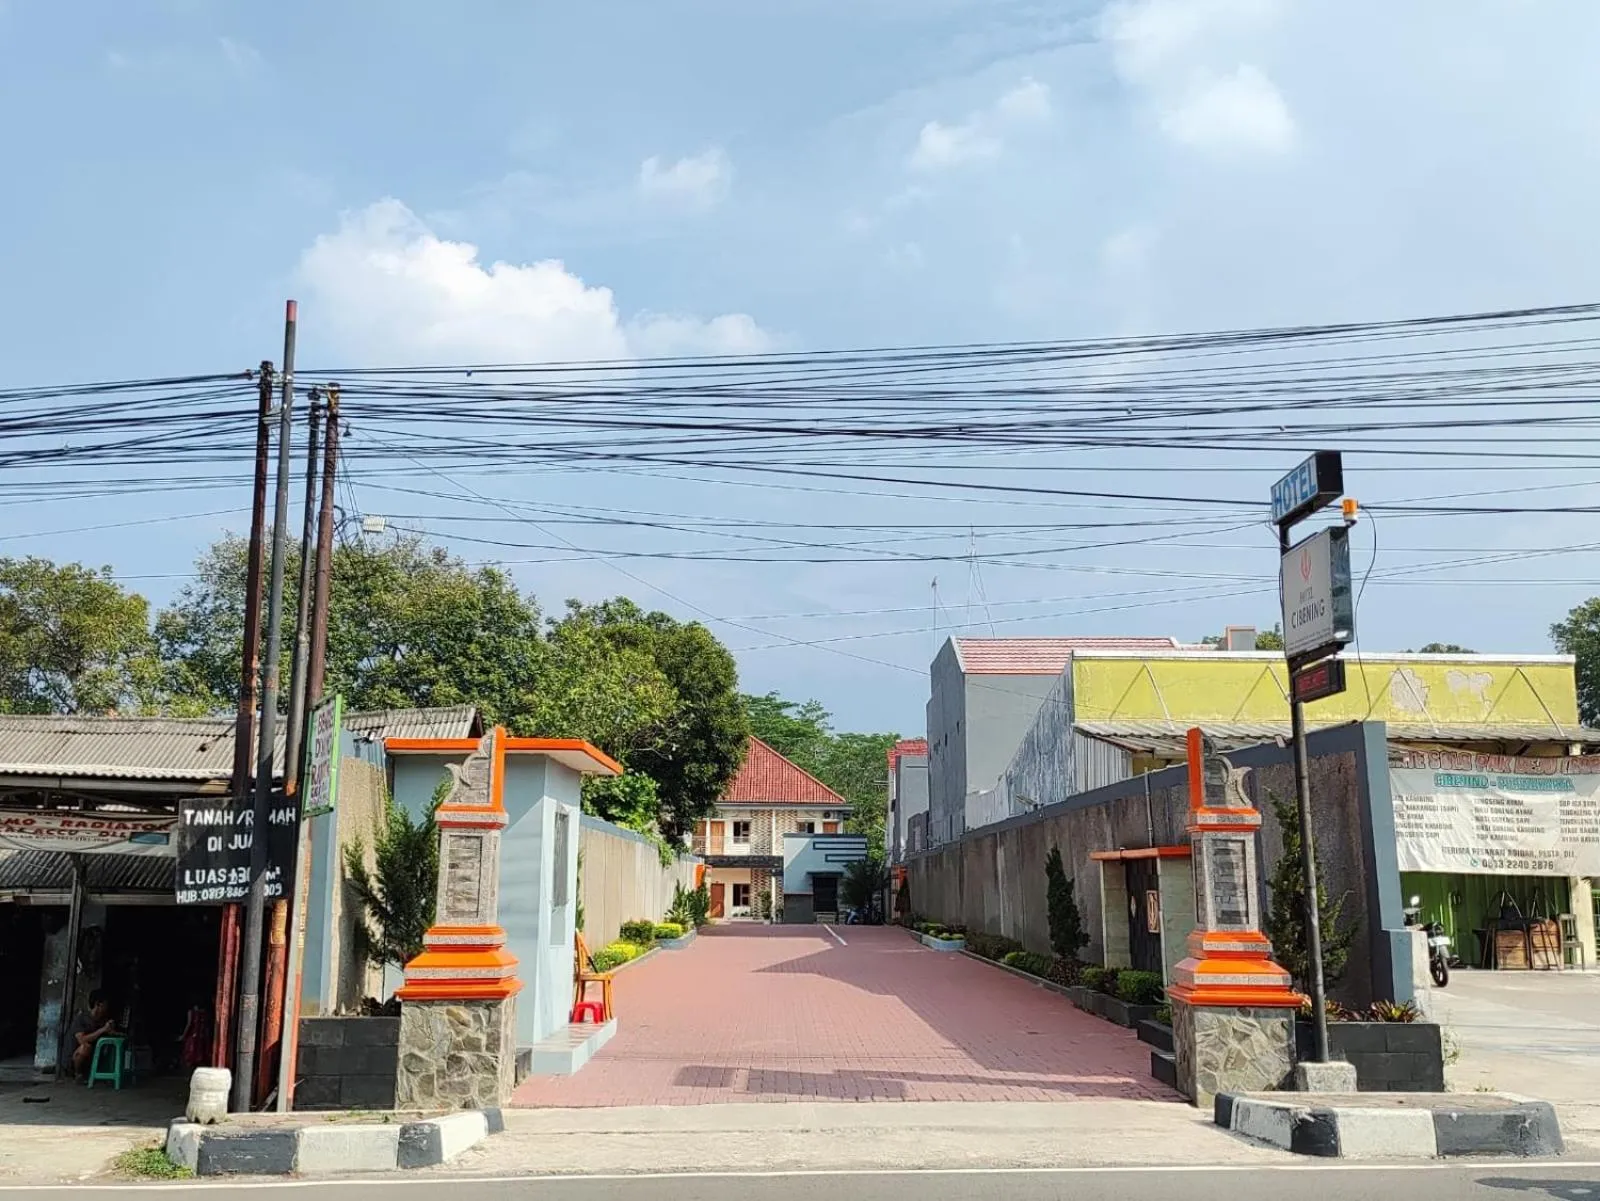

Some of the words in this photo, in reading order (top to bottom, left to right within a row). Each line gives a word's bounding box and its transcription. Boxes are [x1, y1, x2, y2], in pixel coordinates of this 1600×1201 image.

[1273, 460, 1317, 519] HOTEL
[207, 836, 222, 852] DI
[185, 867, 227, 885] LUAS
